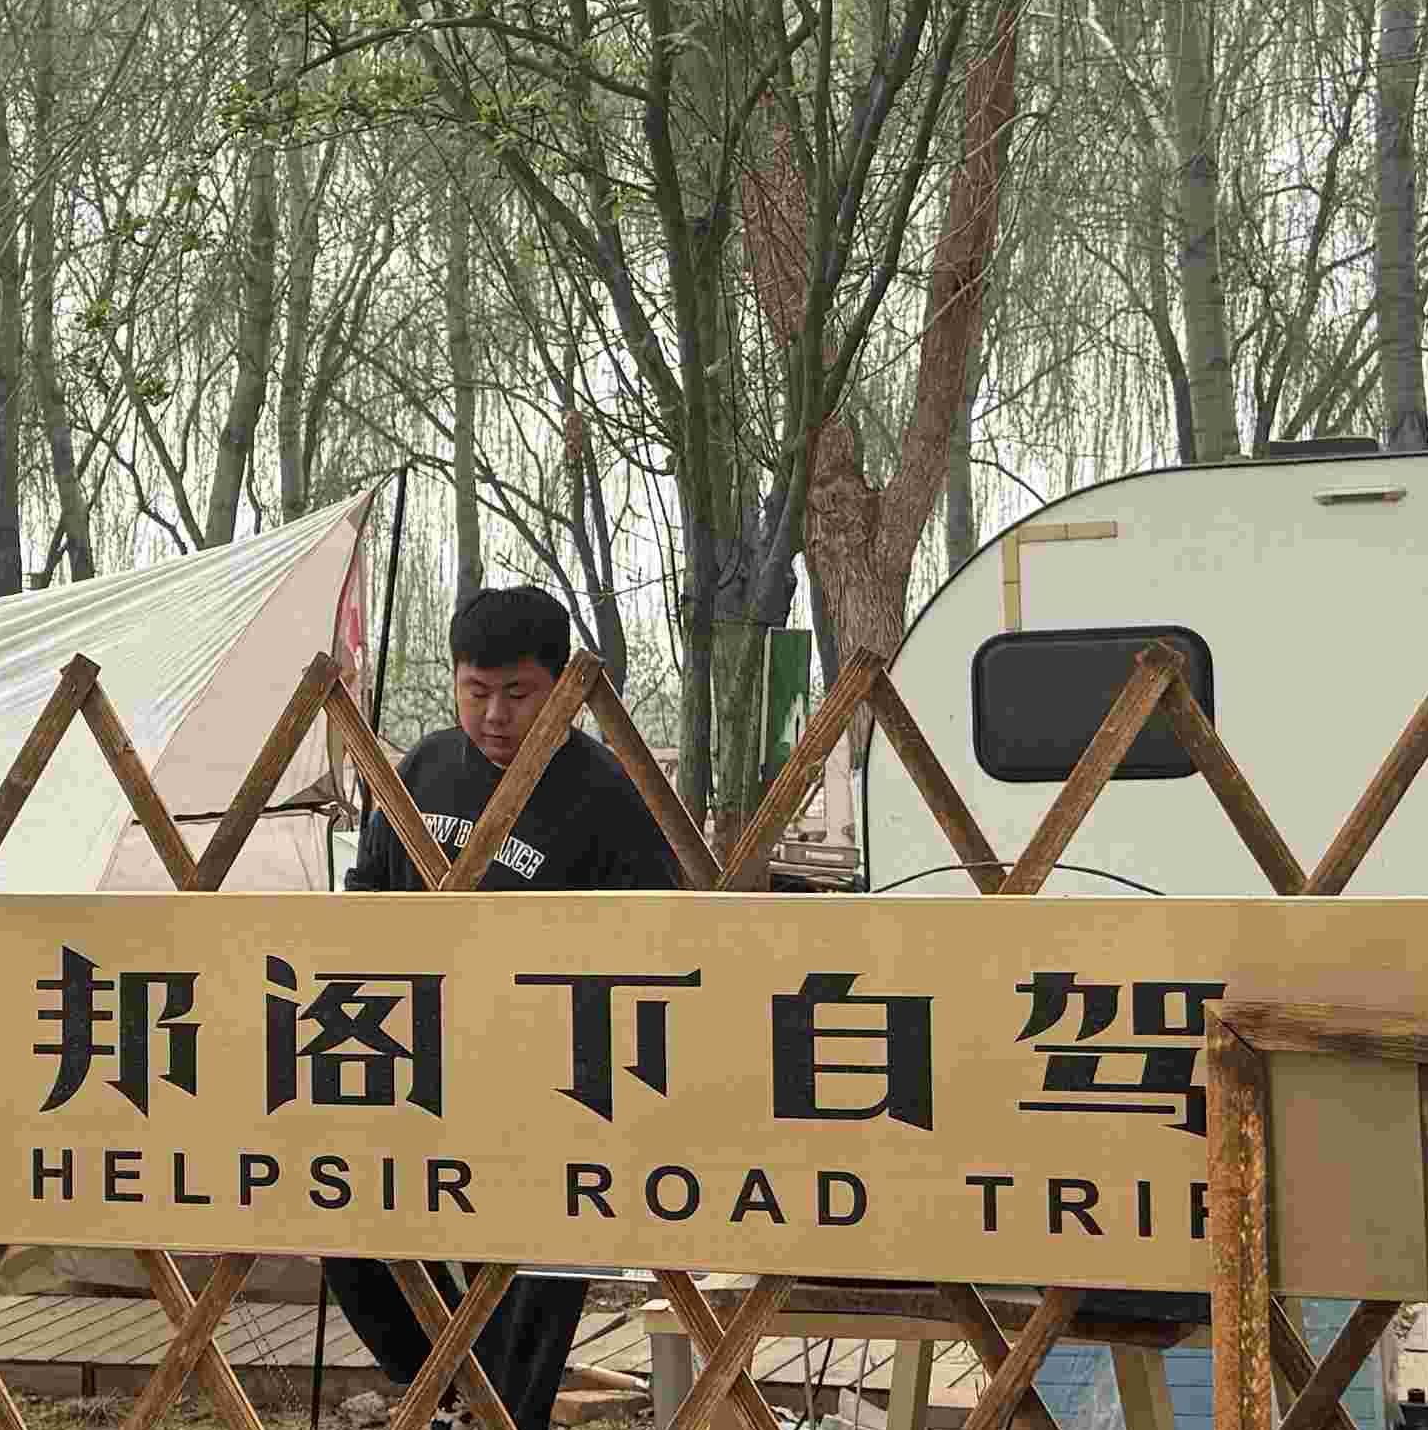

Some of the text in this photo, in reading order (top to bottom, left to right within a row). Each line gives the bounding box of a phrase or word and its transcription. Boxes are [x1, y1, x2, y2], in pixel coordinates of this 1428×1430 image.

[32, 944, 1229, 1139] 邦阁下自驾
[31, 1147, 476, 1214] HELPSIR
[566, 1163, 868, 1228] ROAD
